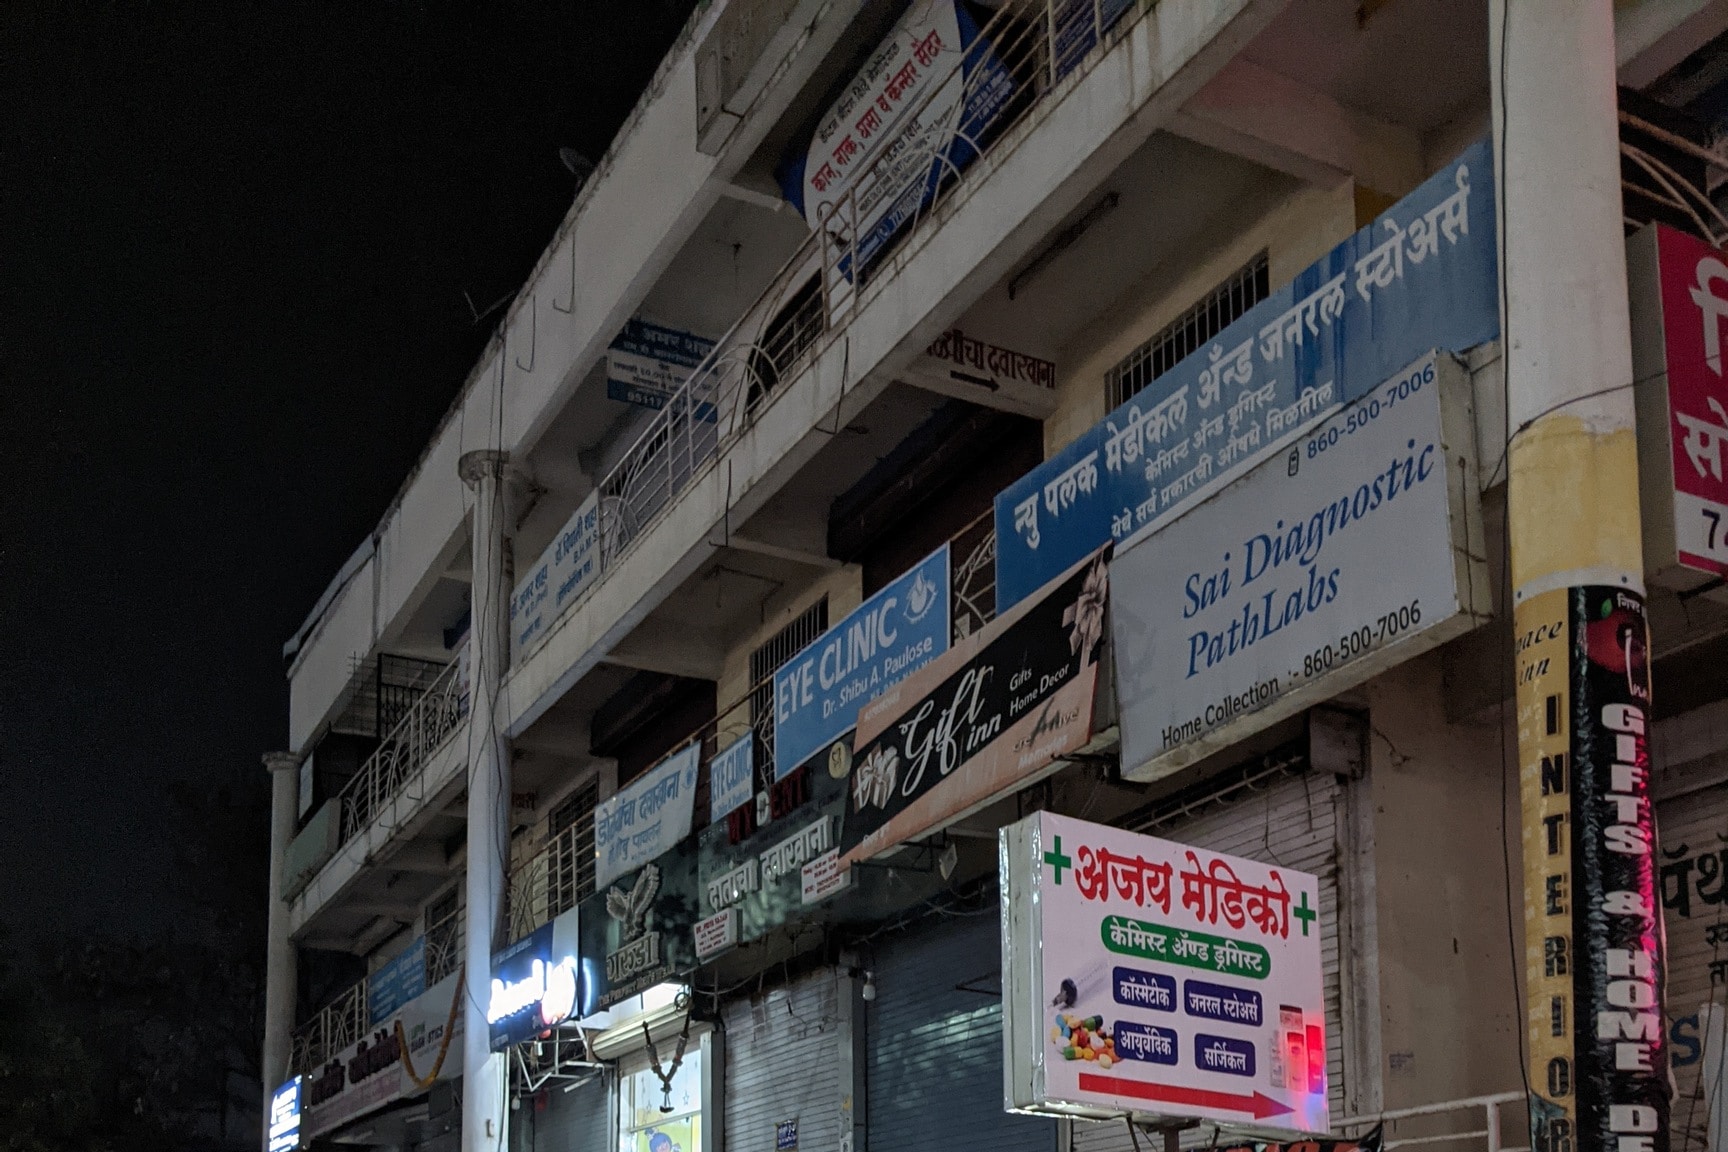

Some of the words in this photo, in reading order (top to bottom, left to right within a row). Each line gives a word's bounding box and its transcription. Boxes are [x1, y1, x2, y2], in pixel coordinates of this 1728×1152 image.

[1044, 451, 1098, 516] पलक
[1106, 385, 1189, 472] मेडीकल
[1259, 273, 1346, 362] जनरल
[1354, 165, 1470, 303] स्टोअर्स
[1307, 364, 1435, 459] 860-500-7006
[1183, 553, 1231, 619] Sai
[1241, 438, 1435, 588] Diagnostic
[779, 658, 815, 725] EYE
[818, 597, 898, 692] CLINIC
[1186, 564, 1341, 680] PathLabs
[822, 699, 837, 720] Dr.
[839, 681, 869, 708] Shibu
[884, 636, 933, 678] Paulose
[1009, 667, 1032, 693] Gifts
[1009, 690, 1038, 718] Home
[1039, 662, 1070, 697] Decor
[1161, 714, 1202, 752] Home
[1205, 676, 1279, 726] Collection
[1303, 600, 1421, 678] 860-500-7006
[898, 665, 995, 797] Gift
[965, 713, 1001, 753] inn
[1600, 703, 1649, 857] GIFTS
[1074, 845, 1174, 916] अजय
[1180, 850, 1291, 940] मेडिको
[1110, 917, 1167, 955] केमिस्ट
[1188, 992, 1222, 1017] जनरल
[1204, 1042, 1247, 1071] सर्जिकल
[1597, 948, 1661, 1073] HOME
